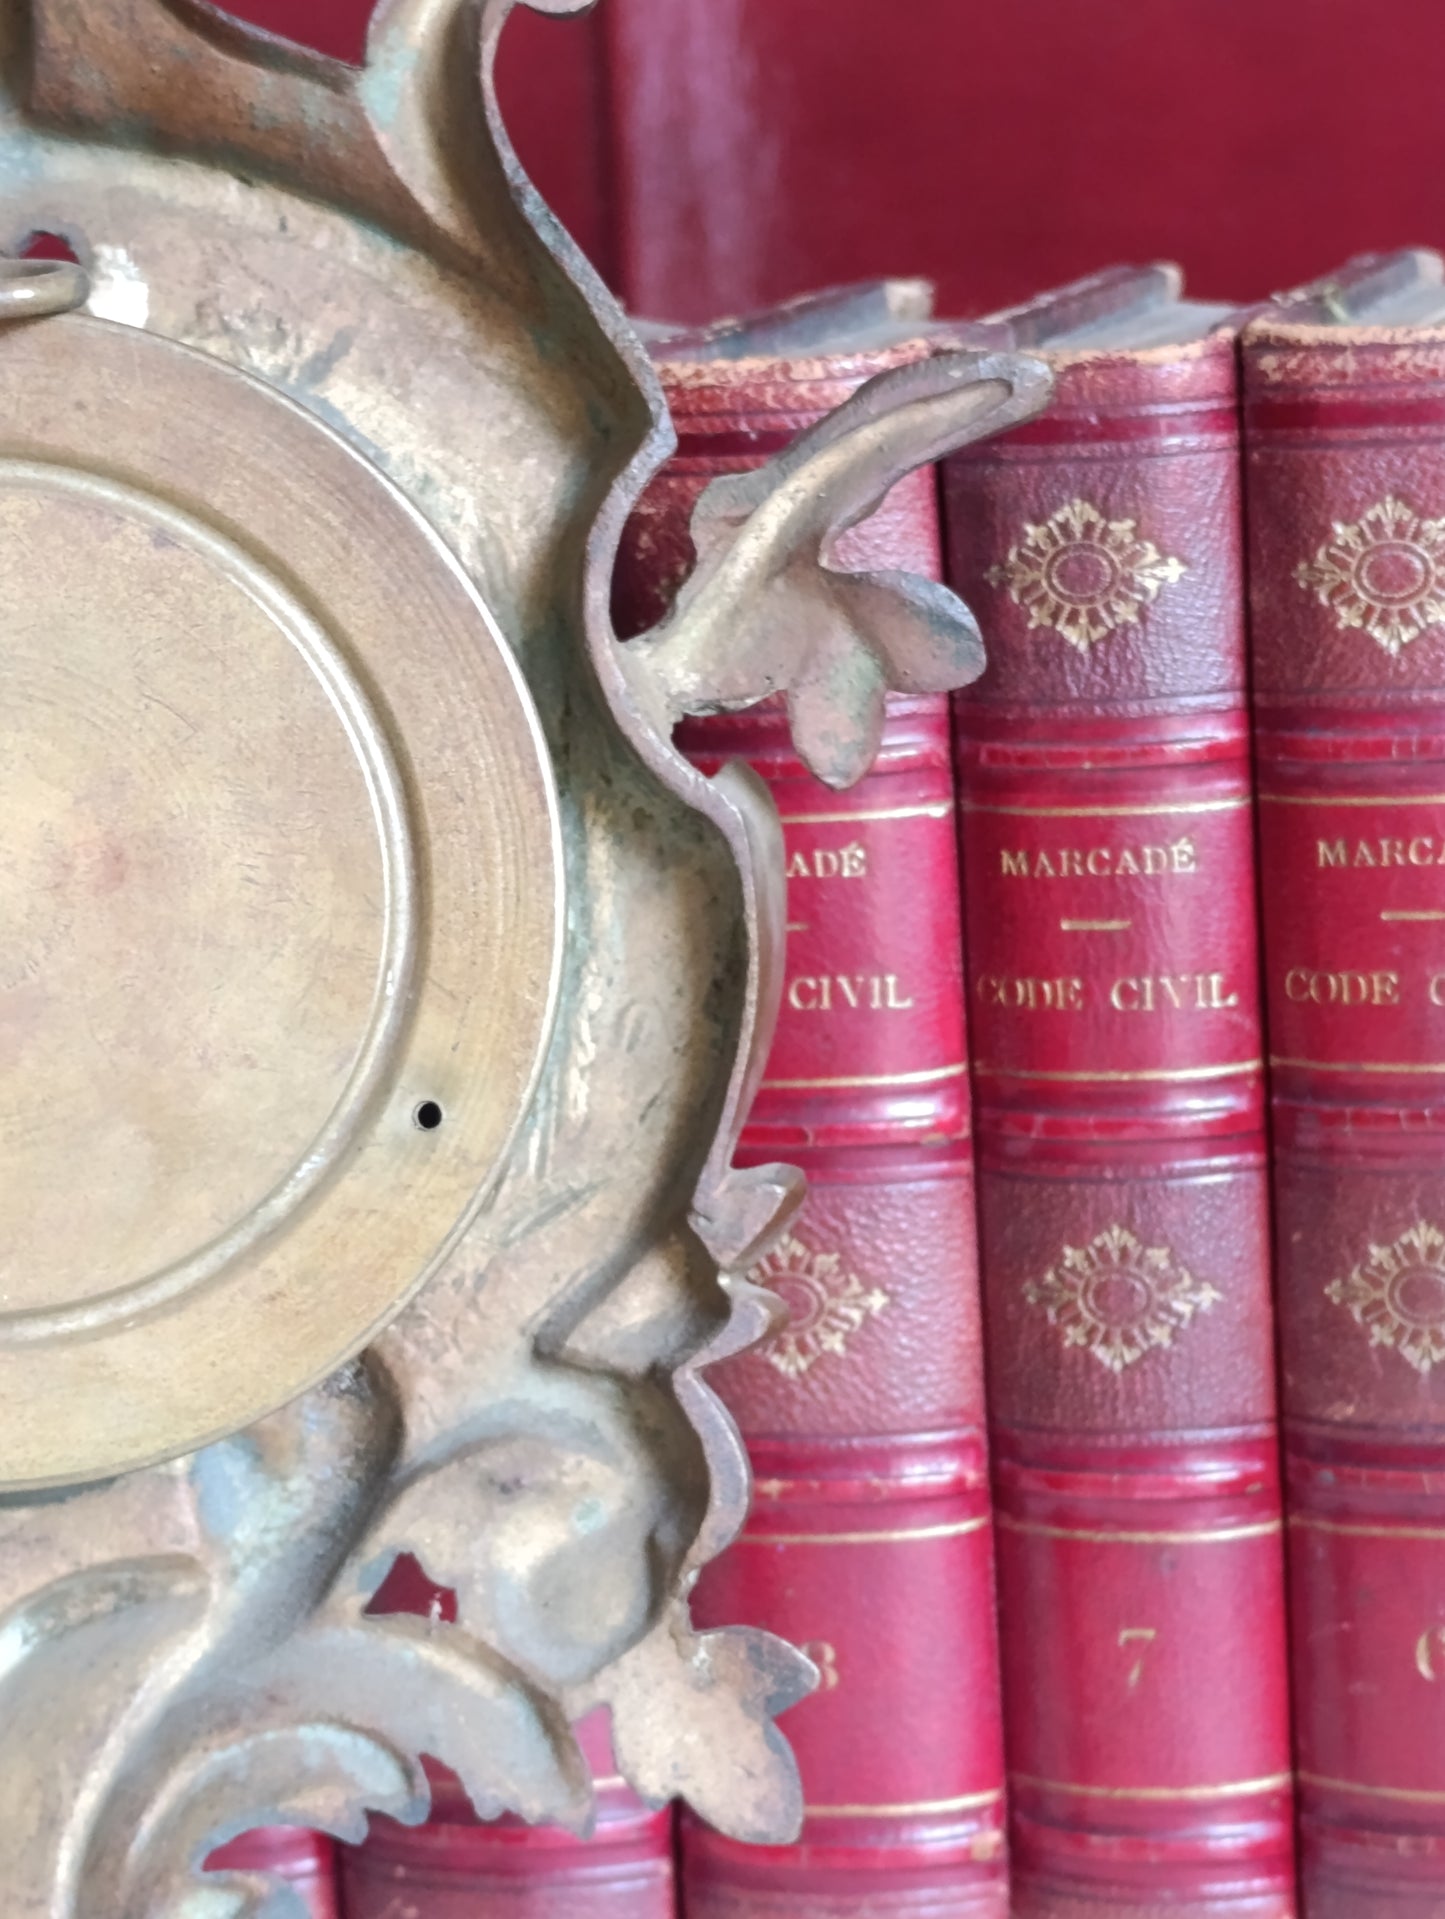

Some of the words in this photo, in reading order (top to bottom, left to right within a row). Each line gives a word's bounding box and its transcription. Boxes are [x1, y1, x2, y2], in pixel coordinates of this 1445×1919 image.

[1000, 838, 1196, 878] MARCADÉ
[788, 974, 914, 1011] CIVIL
[976, 975, 1083, 1010] CODE
[1110, 972, 1239, 1011] CIVIL
[1285, 968, 1399, 1005] CODE
[1117, 1627, 1157, 1695] 7
